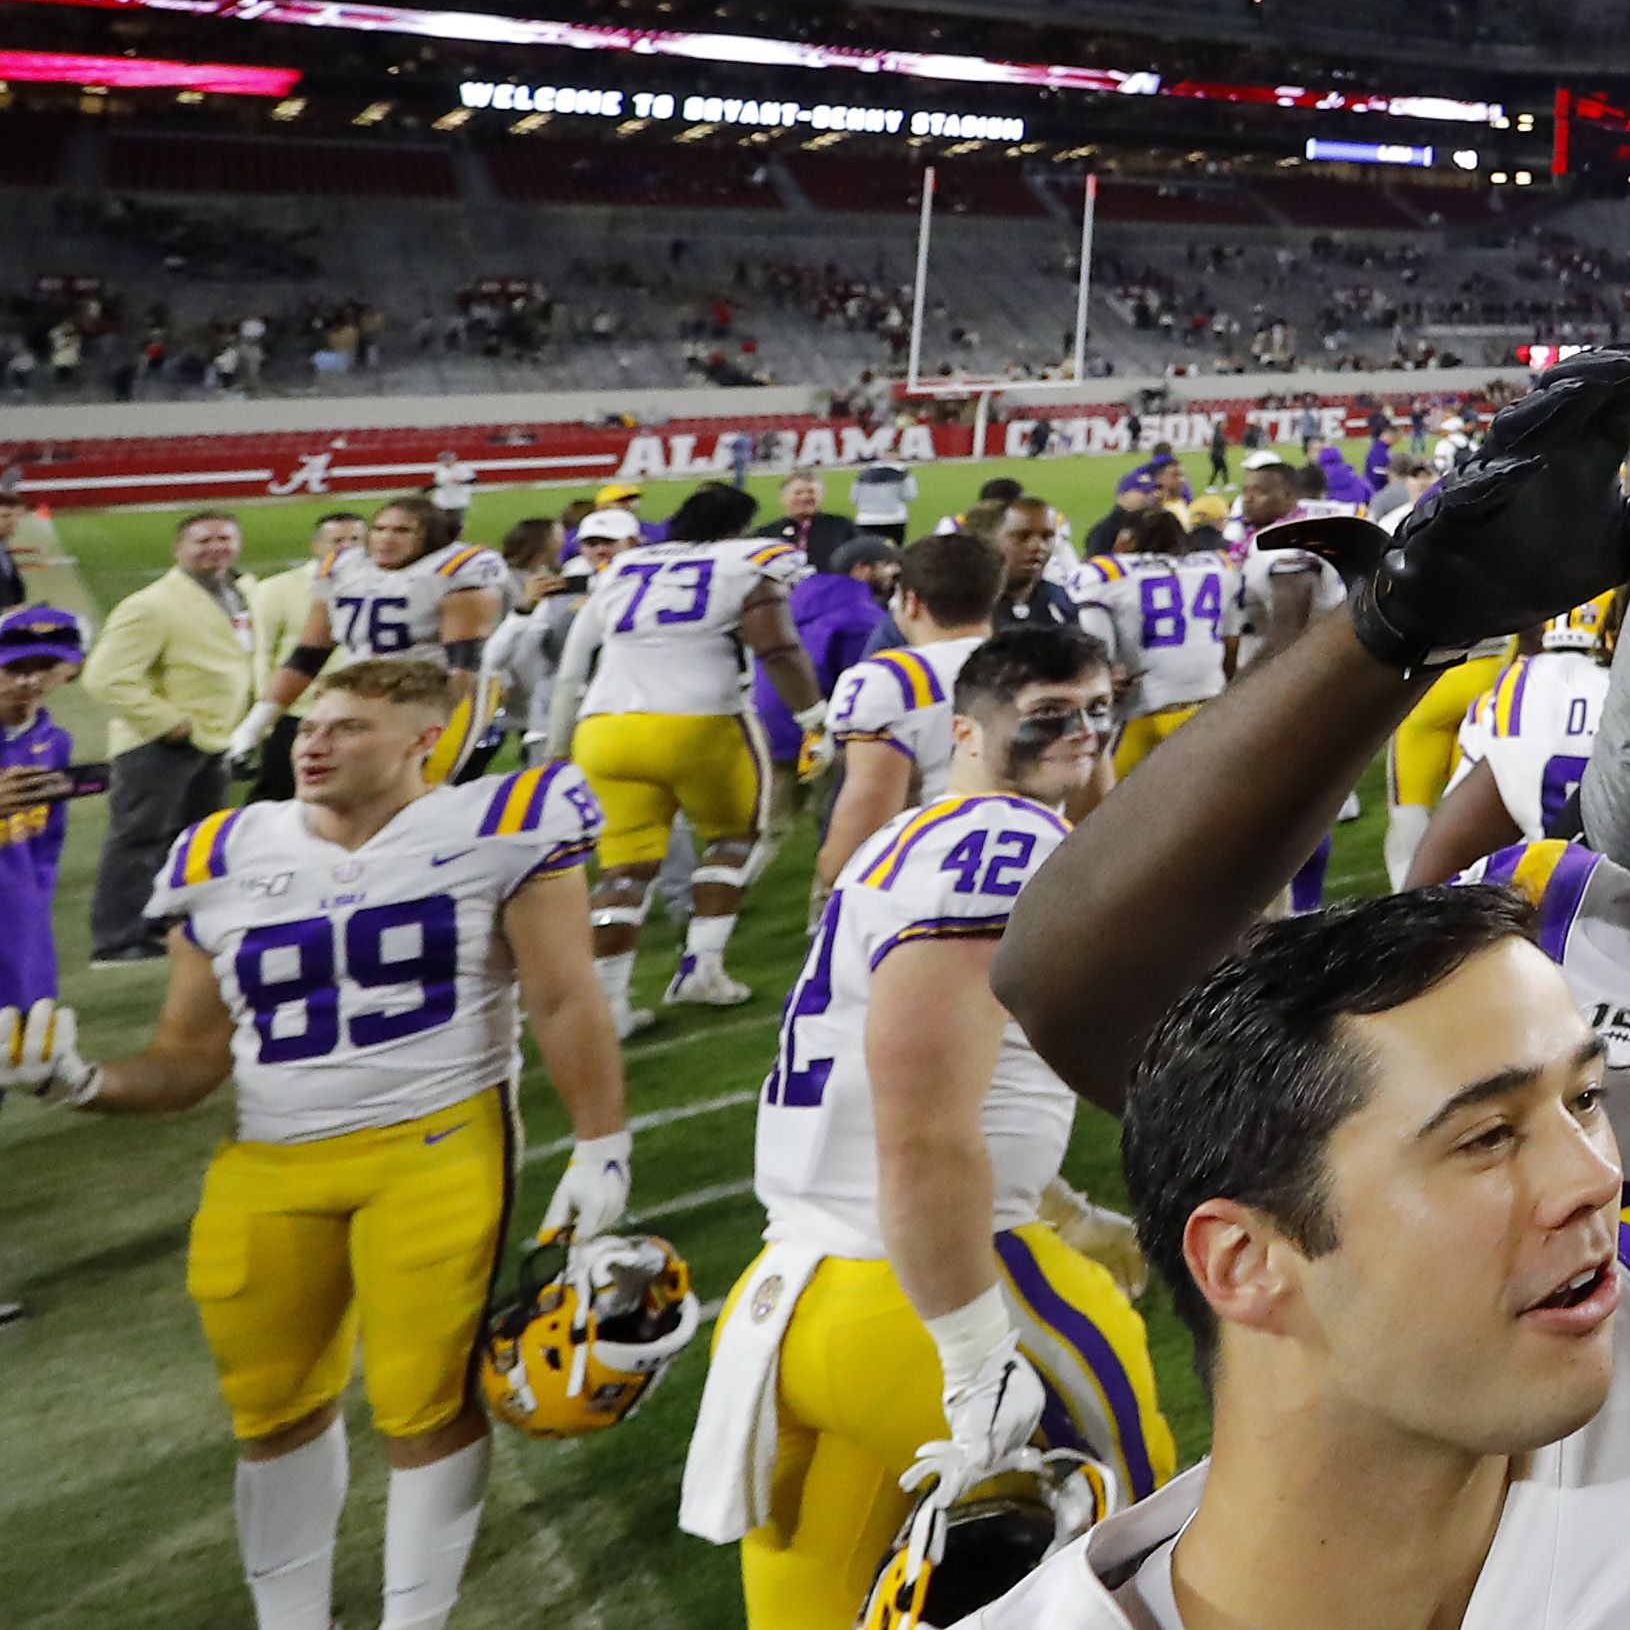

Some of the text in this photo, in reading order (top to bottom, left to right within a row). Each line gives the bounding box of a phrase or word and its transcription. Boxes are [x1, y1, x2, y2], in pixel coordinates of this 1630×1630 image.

[459, 81, 624, 117] WELCOME
[631, 93, 675, 120] TO
[909, 111, 1026, 141] STADIUM
[336, 597, 411, 654] 76
[615, 559, 716, 634] 73
[1141, 573, 1224, 649] 84
[940, 829, 1037, 896] 42
[235, 893, 457, 1065] 89
